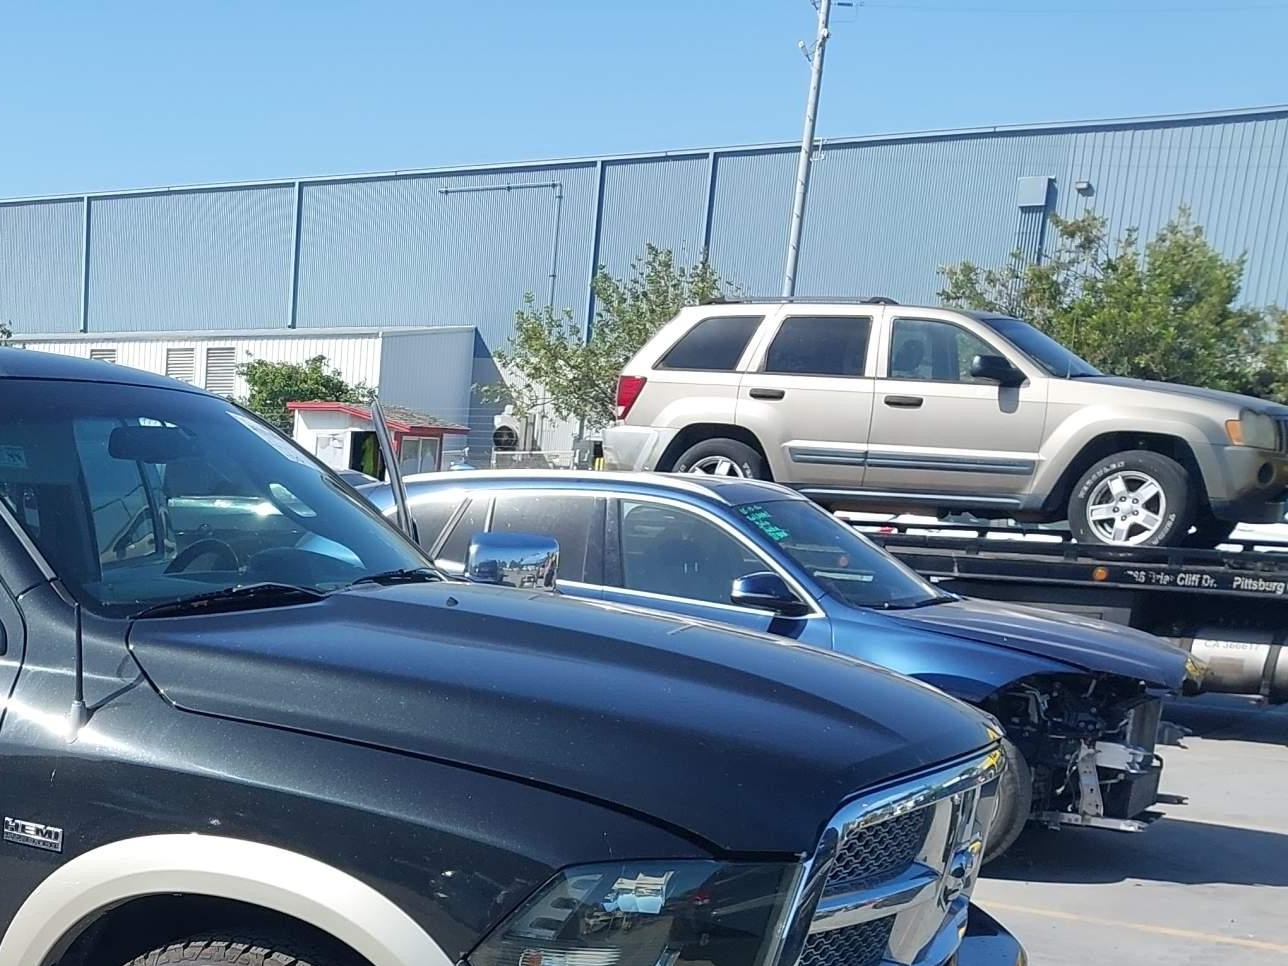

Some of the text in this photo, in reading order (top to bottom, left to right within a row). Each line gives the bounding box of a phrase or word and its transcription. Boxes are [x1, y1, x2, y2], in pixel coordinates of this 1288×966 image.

[1176, 572, 1200, 587] Cliff
[1232, 576, 1286, 595] Pittsburg
[3, 817, 63, 842] HEMI
